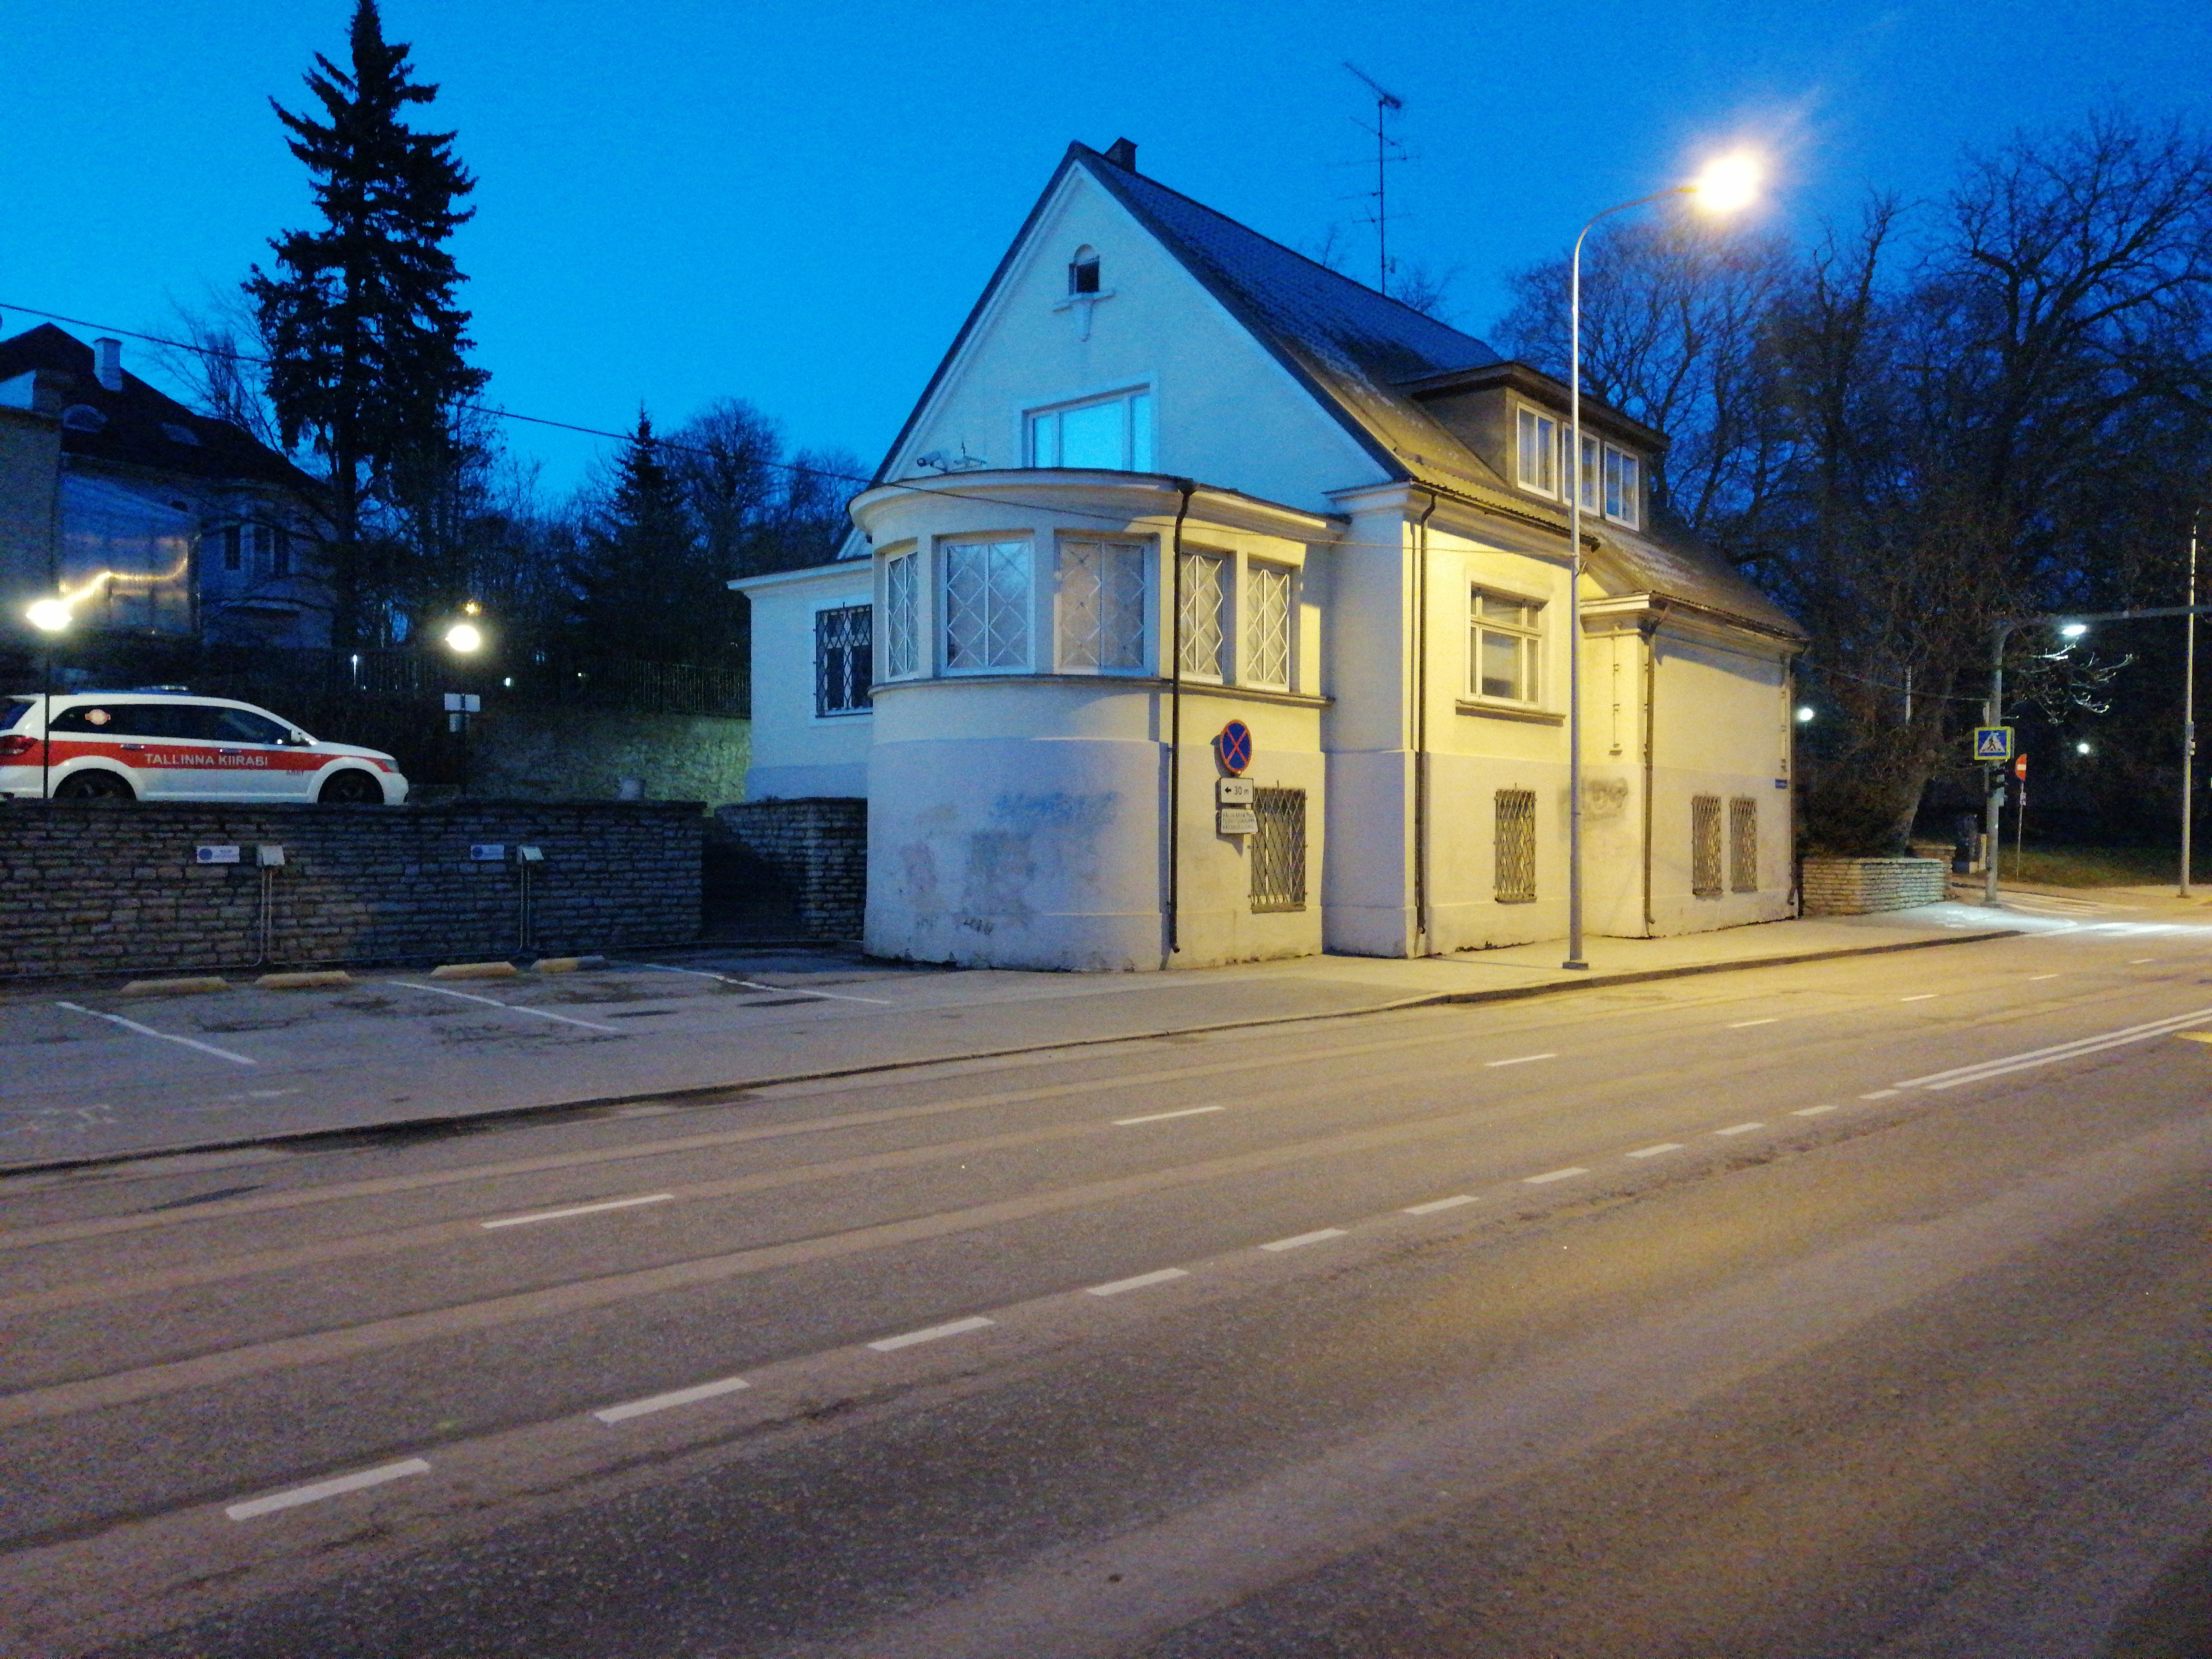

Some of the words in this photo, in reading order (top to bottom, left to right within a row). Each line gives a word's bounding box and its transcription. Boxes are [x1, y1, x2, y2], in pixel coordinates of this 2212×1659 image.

[144, 753, 214, 765] TALLINNA
[218, 755, 268, 766] KIIRABI
[1234, 786, 1242, 795] 30
